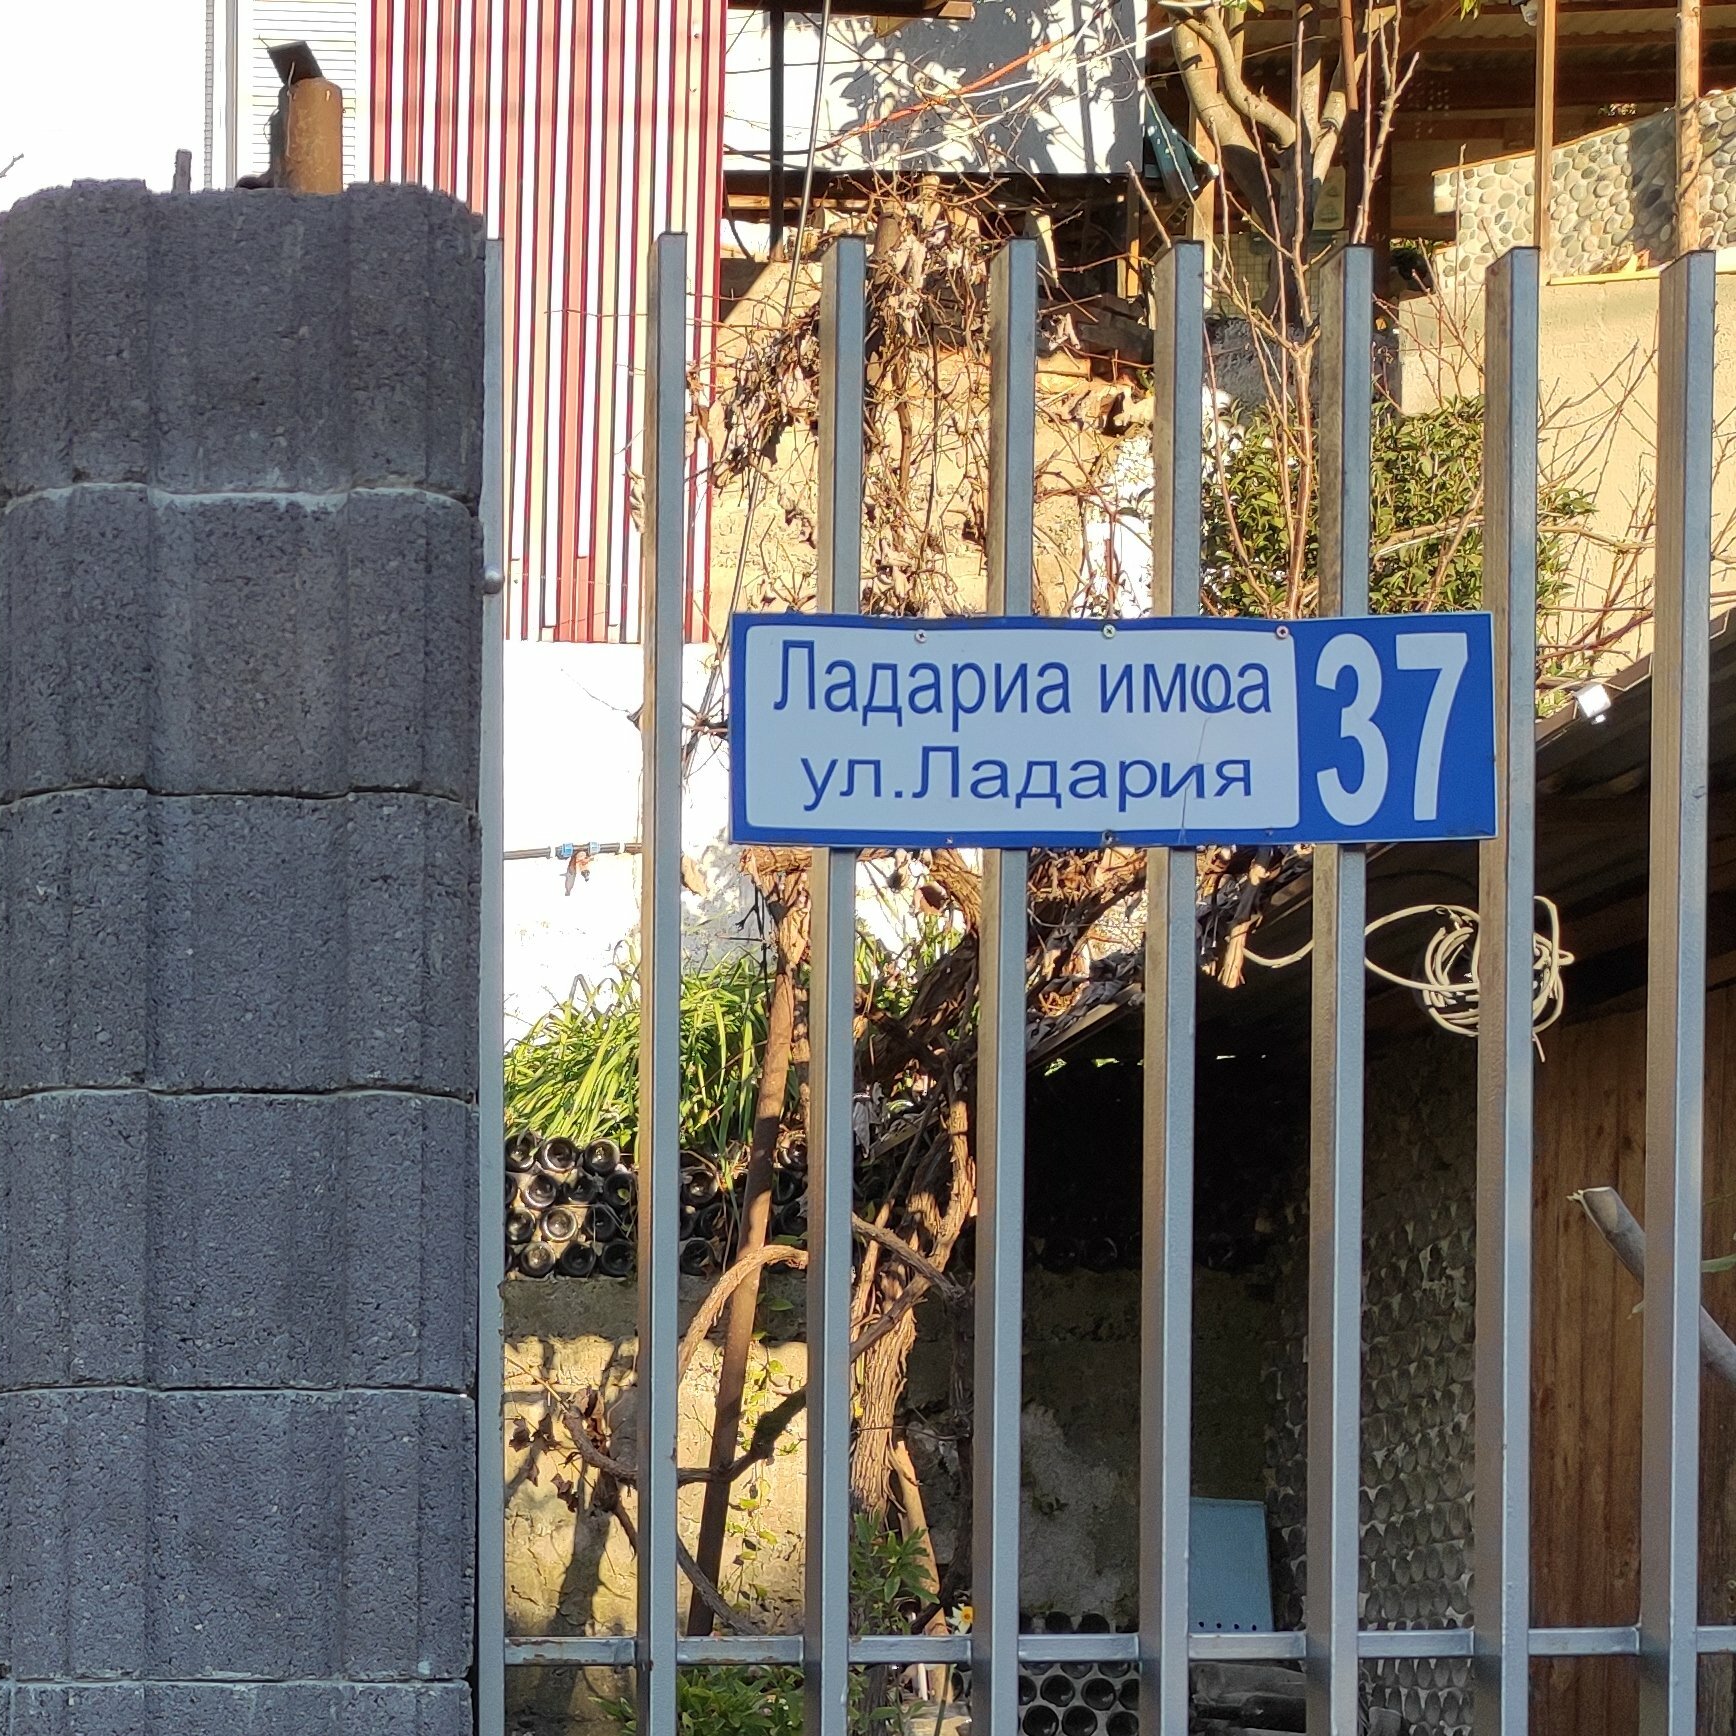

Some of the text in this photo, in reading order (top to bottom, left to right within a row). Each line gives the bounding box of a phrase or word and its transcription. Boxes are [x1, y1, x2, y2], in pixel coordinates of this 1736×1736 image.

[774, 639, 1071, 732] Ладариа
[1315, 632, 1468, 826] 37
[800, 745, 1252, 813] ул.Ладария
